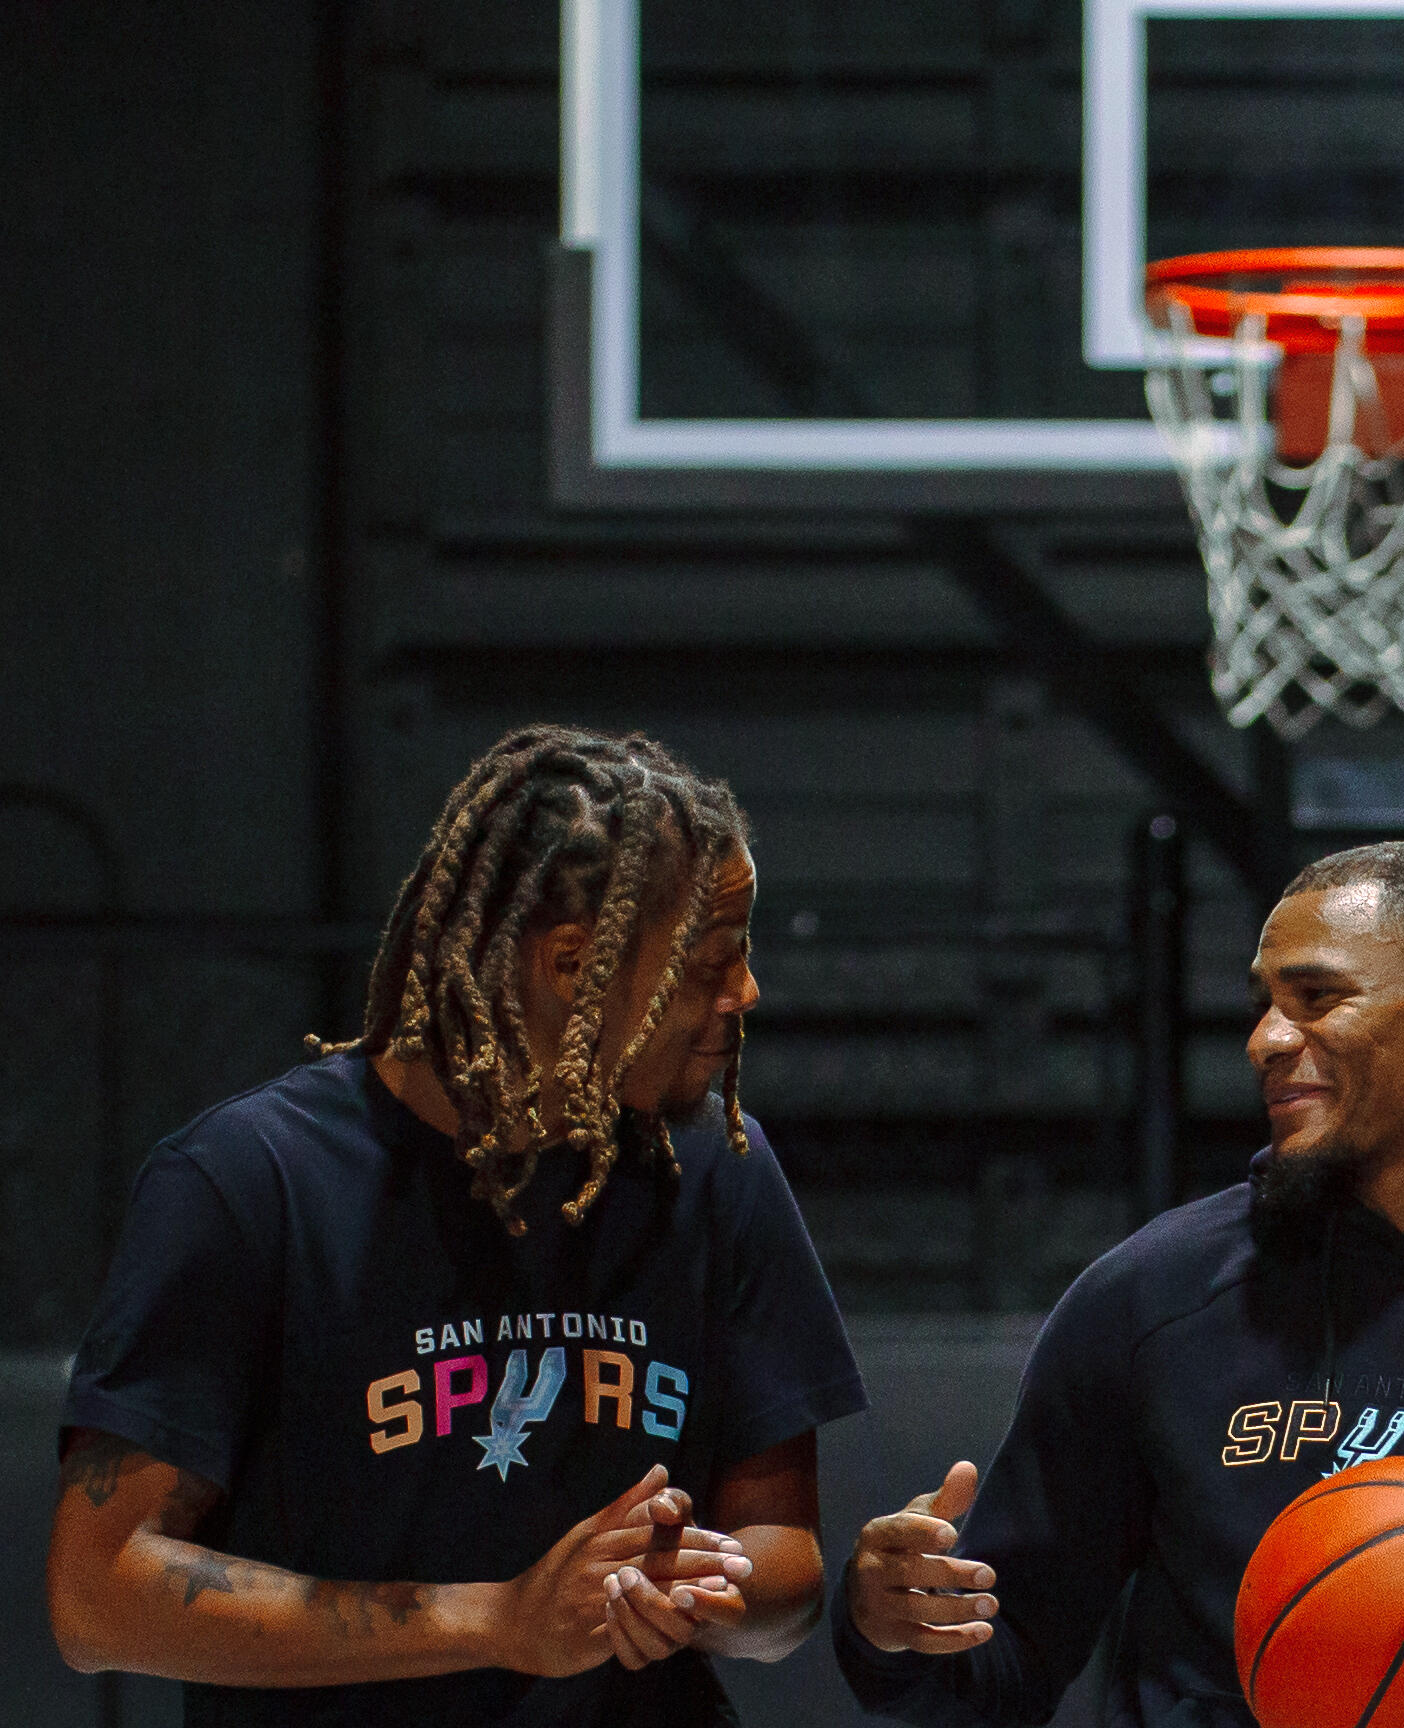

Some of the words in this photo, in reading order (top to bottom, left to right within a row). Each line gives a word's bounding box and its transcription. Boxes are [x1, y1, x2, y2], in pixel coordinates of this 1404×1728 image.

[415, 1318, 484, 1355] SAN
[497, 1312, 649, 1347] ANTONIO
[366, 1346, 690, 1484] SPURS
